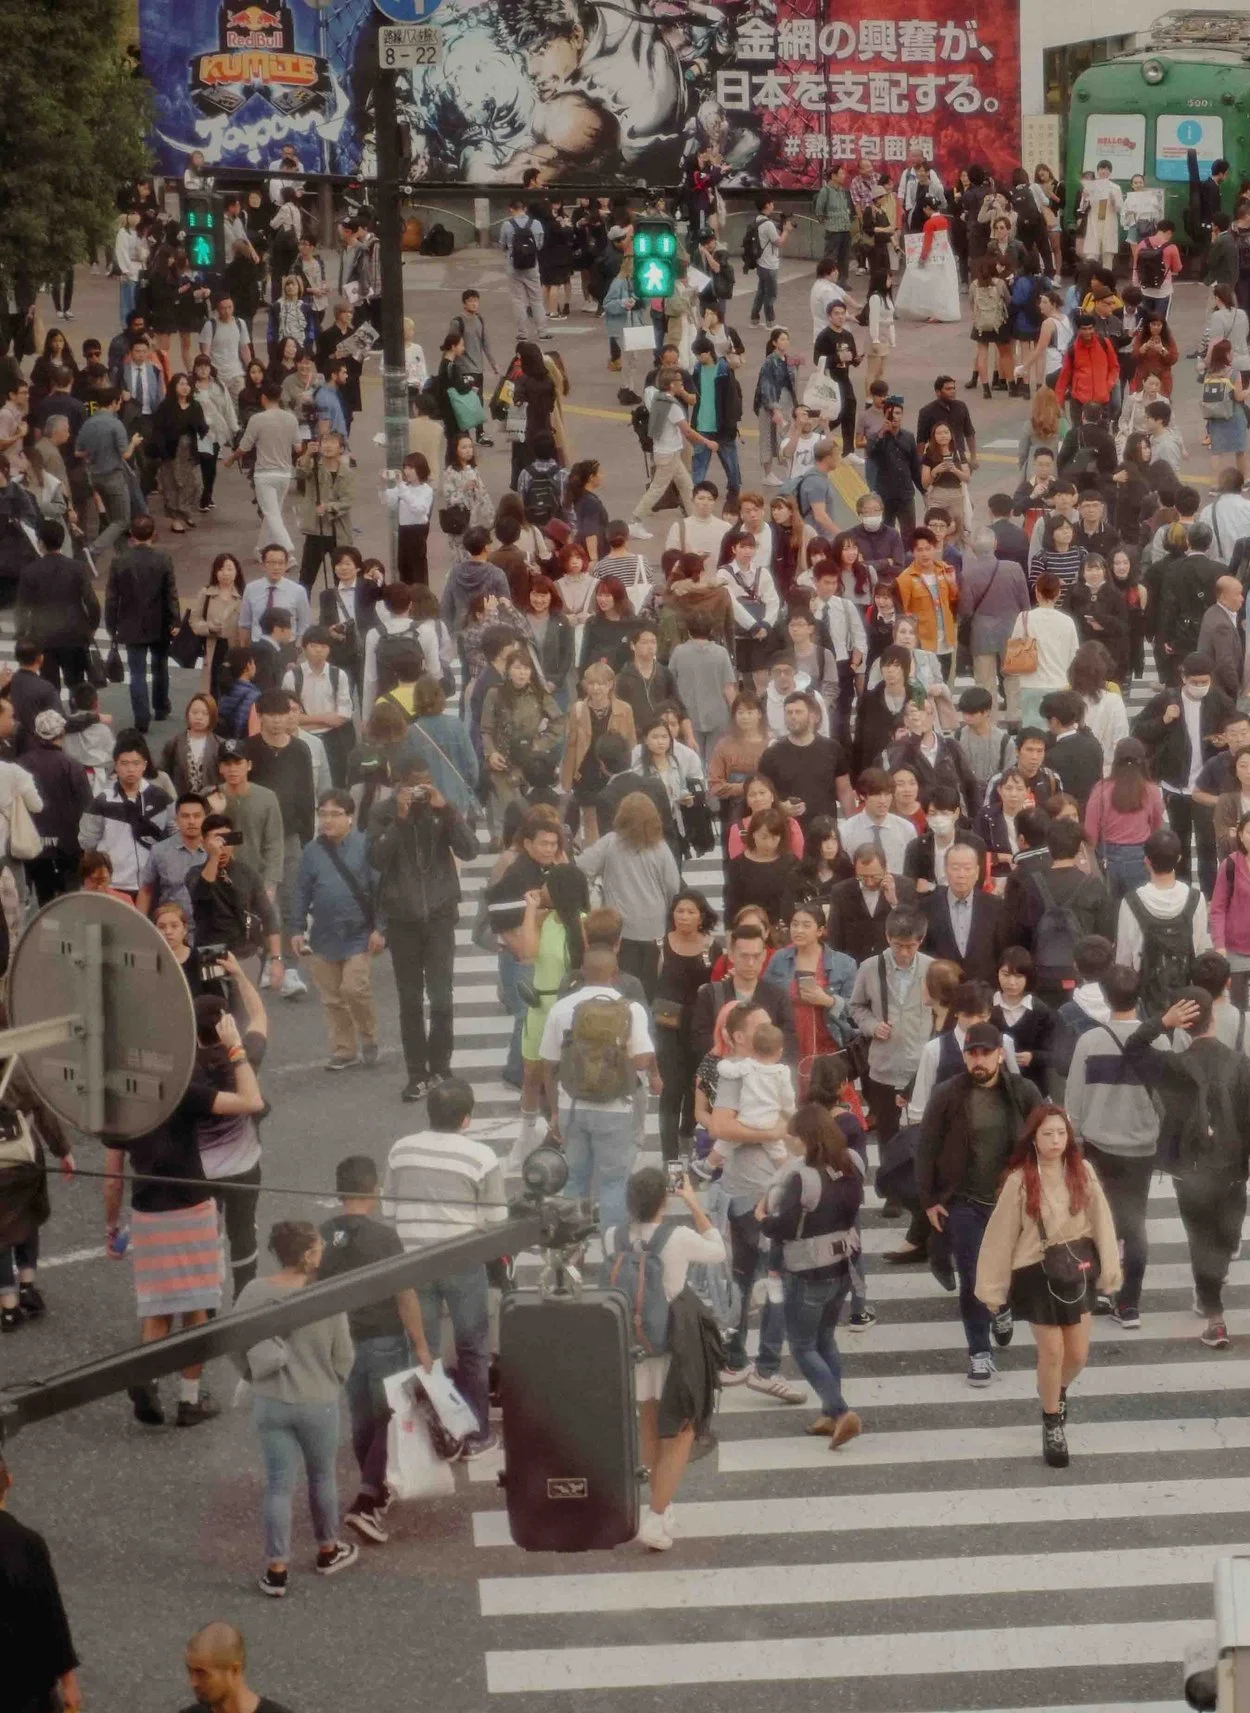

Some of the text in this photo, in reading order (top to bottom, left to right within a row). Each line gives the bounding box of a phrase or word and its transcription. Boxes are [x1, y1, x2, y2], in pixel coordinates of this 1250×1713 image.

[227, 31, 283, 48] Red Bull
[735, 18, 994, 62] 金網の興奮が、
[716, 70, 999, 113] 日本を支配する。
[784, 134, 934, 161] #熱狂包囲網
